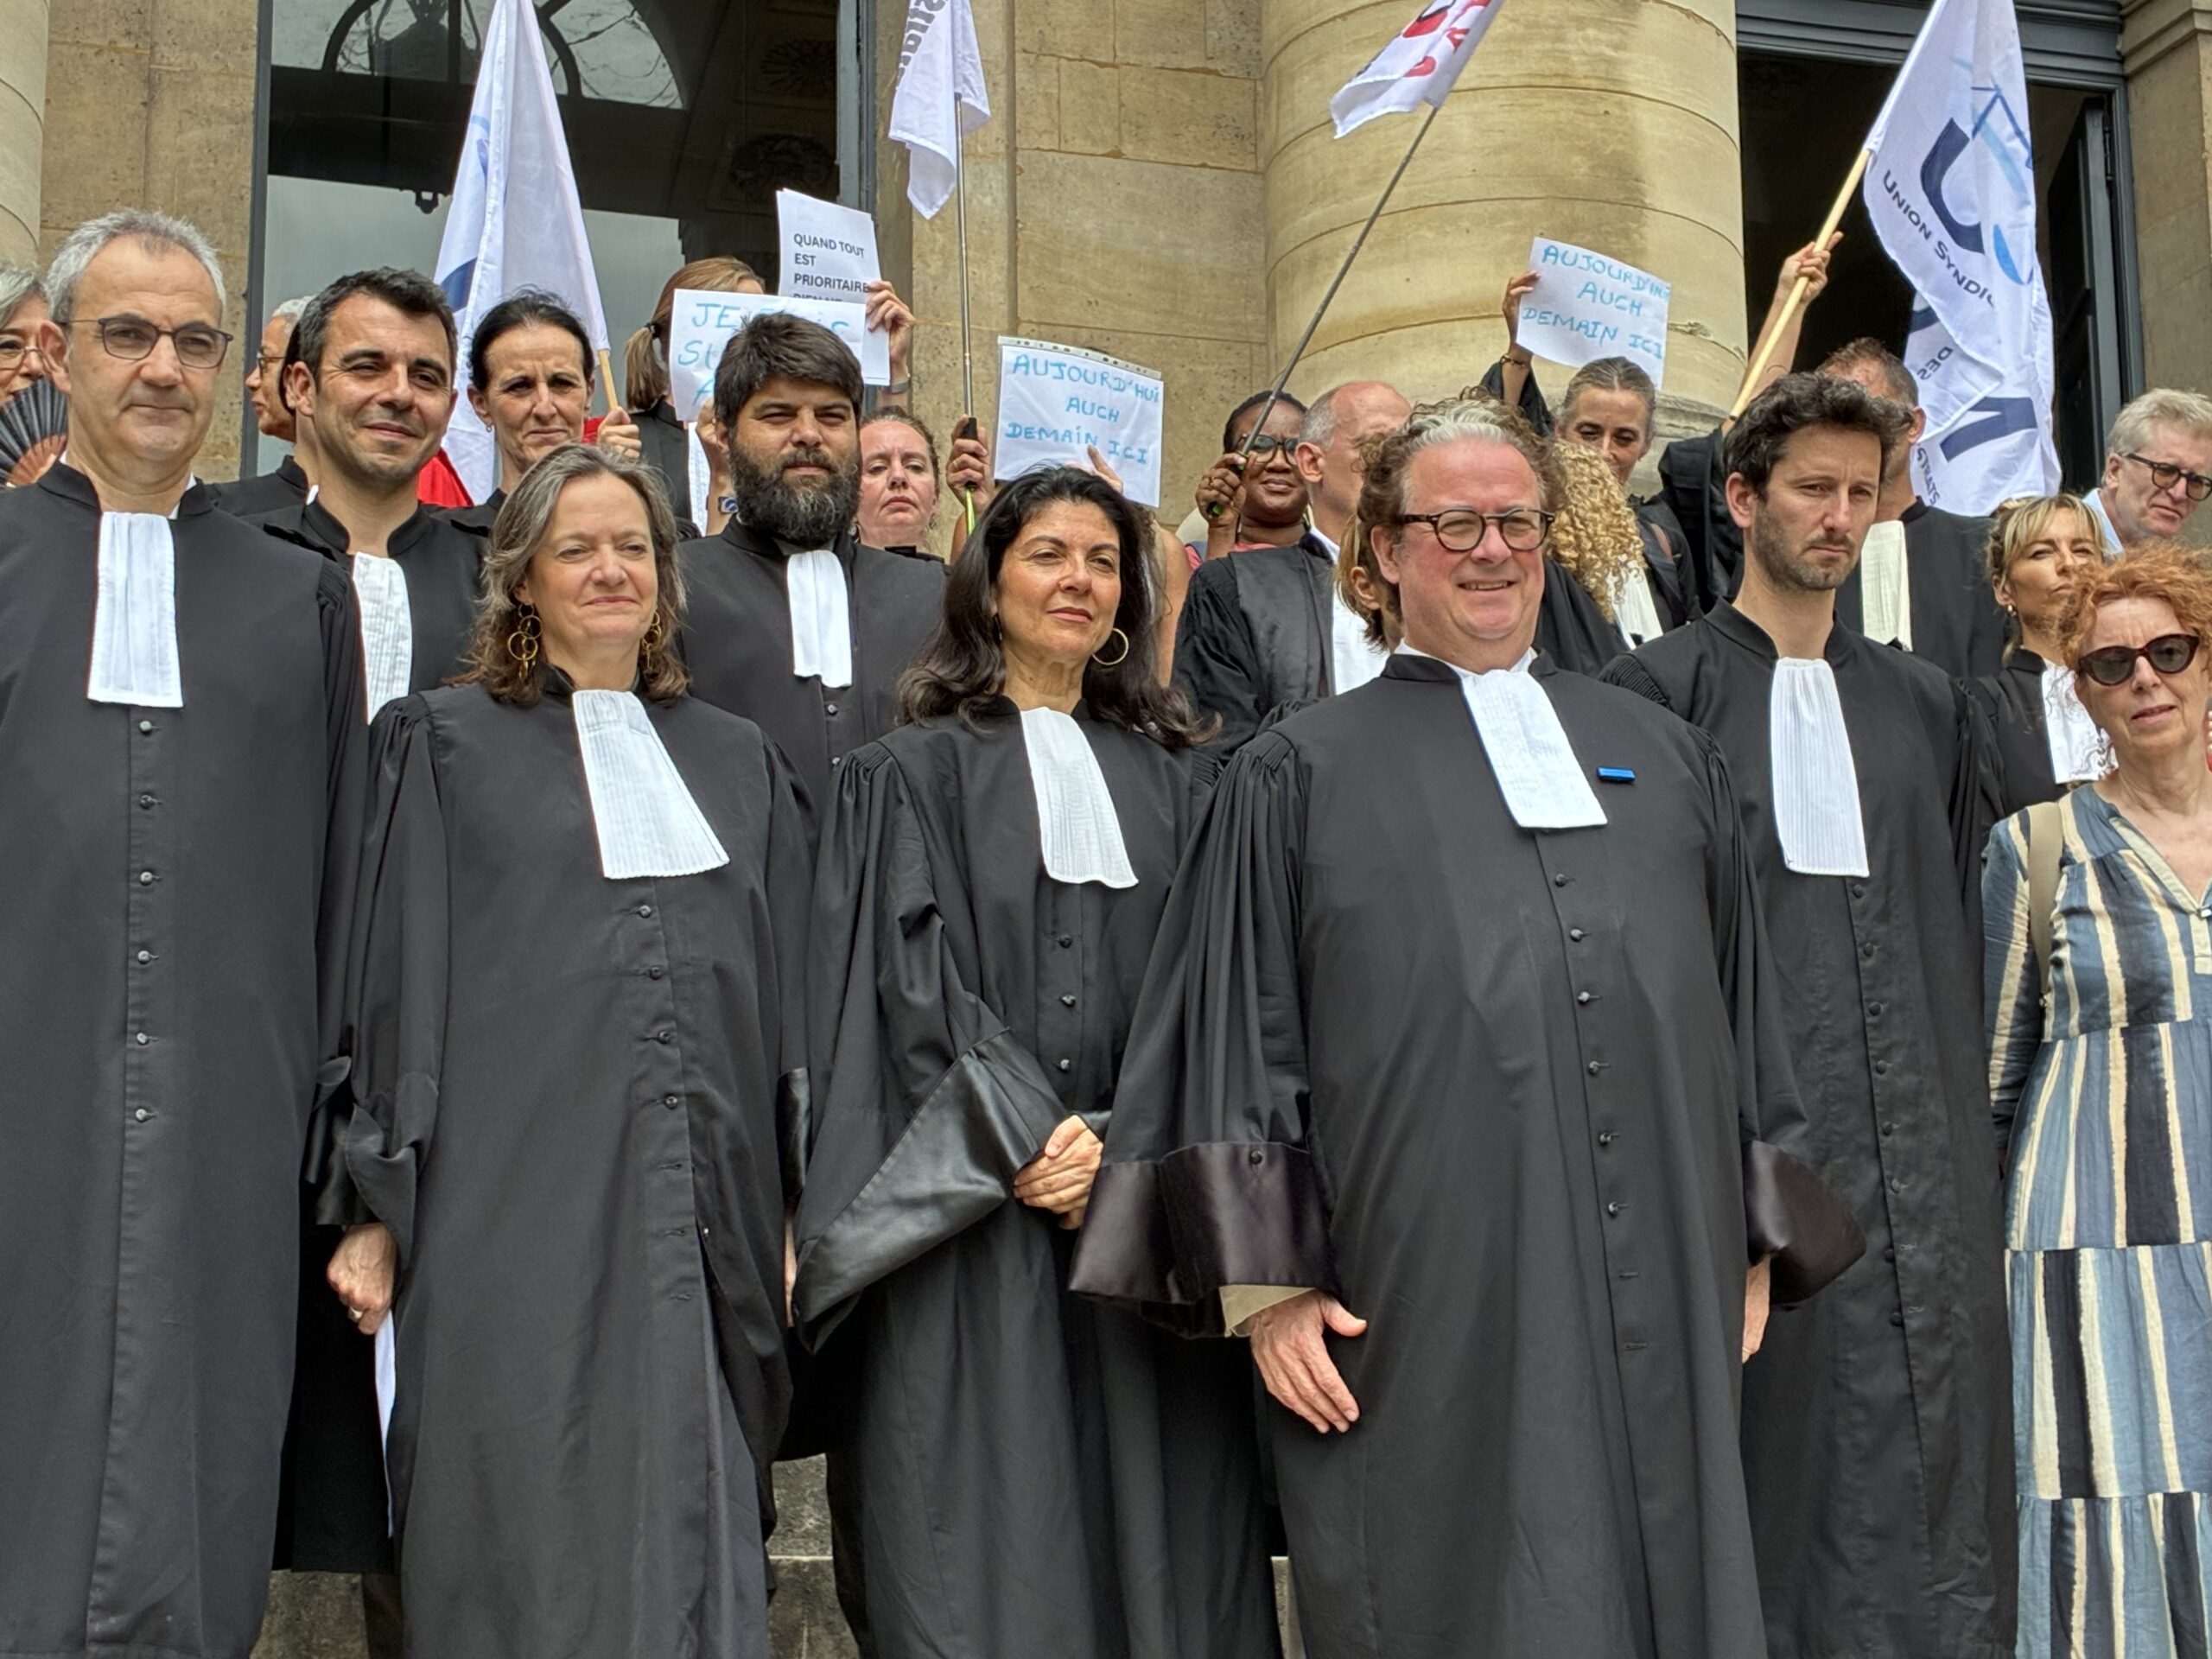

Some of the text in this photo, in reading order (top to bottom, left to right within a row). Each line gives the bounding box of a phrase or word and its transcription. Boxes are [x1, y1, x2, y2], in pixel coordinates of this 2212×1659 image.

[1883, 168, 1932, 241] UNION
[793, 232, 865, 258] QUAND TOUT
[794, 253, 817, 266] EST
[1577, 281, 1643, 317] AUCH
[691, 302, 741, 329] JE
[1522, 307, 1663, 359] DEMAIN ICI
[1065, 397, 1121, 423] AUCH
[1108, 439, 1148, 465] ICI
[1916, 447, 1942, 506] STRATS
